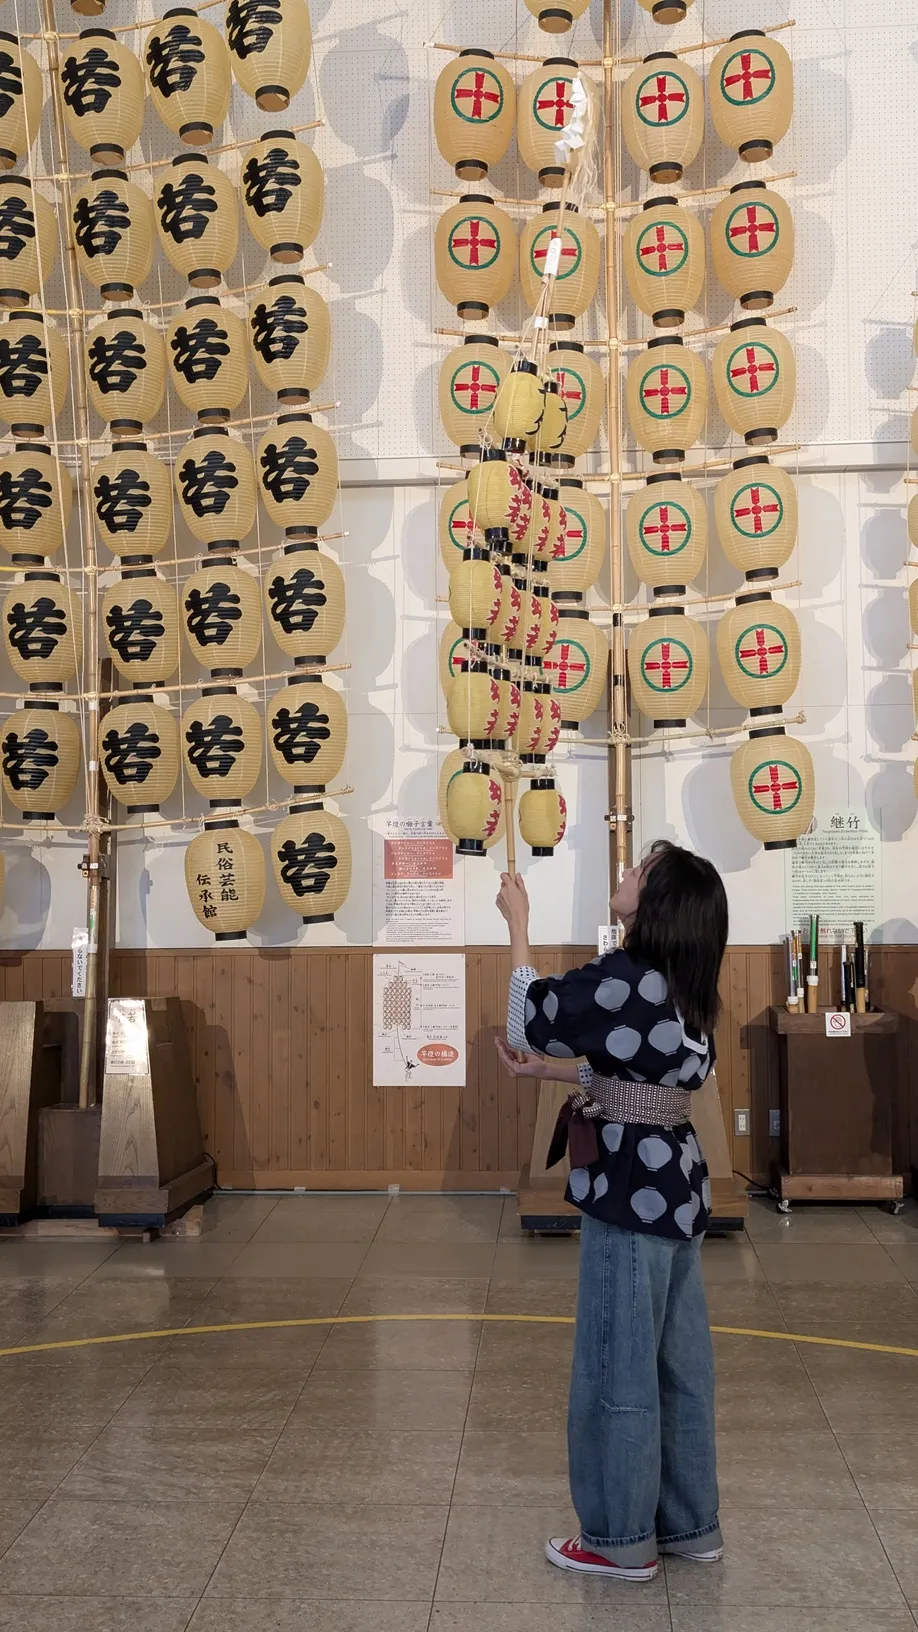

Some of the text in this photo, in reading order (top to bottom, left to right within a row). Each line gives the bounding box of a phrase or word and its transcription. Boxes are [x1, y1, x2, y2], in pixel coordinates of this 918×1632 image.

[830, 815, 861, 830] 継竹
[217, 842, 239, 901] 民俗芸能
[196, 873, 218, 918] 伝承館
